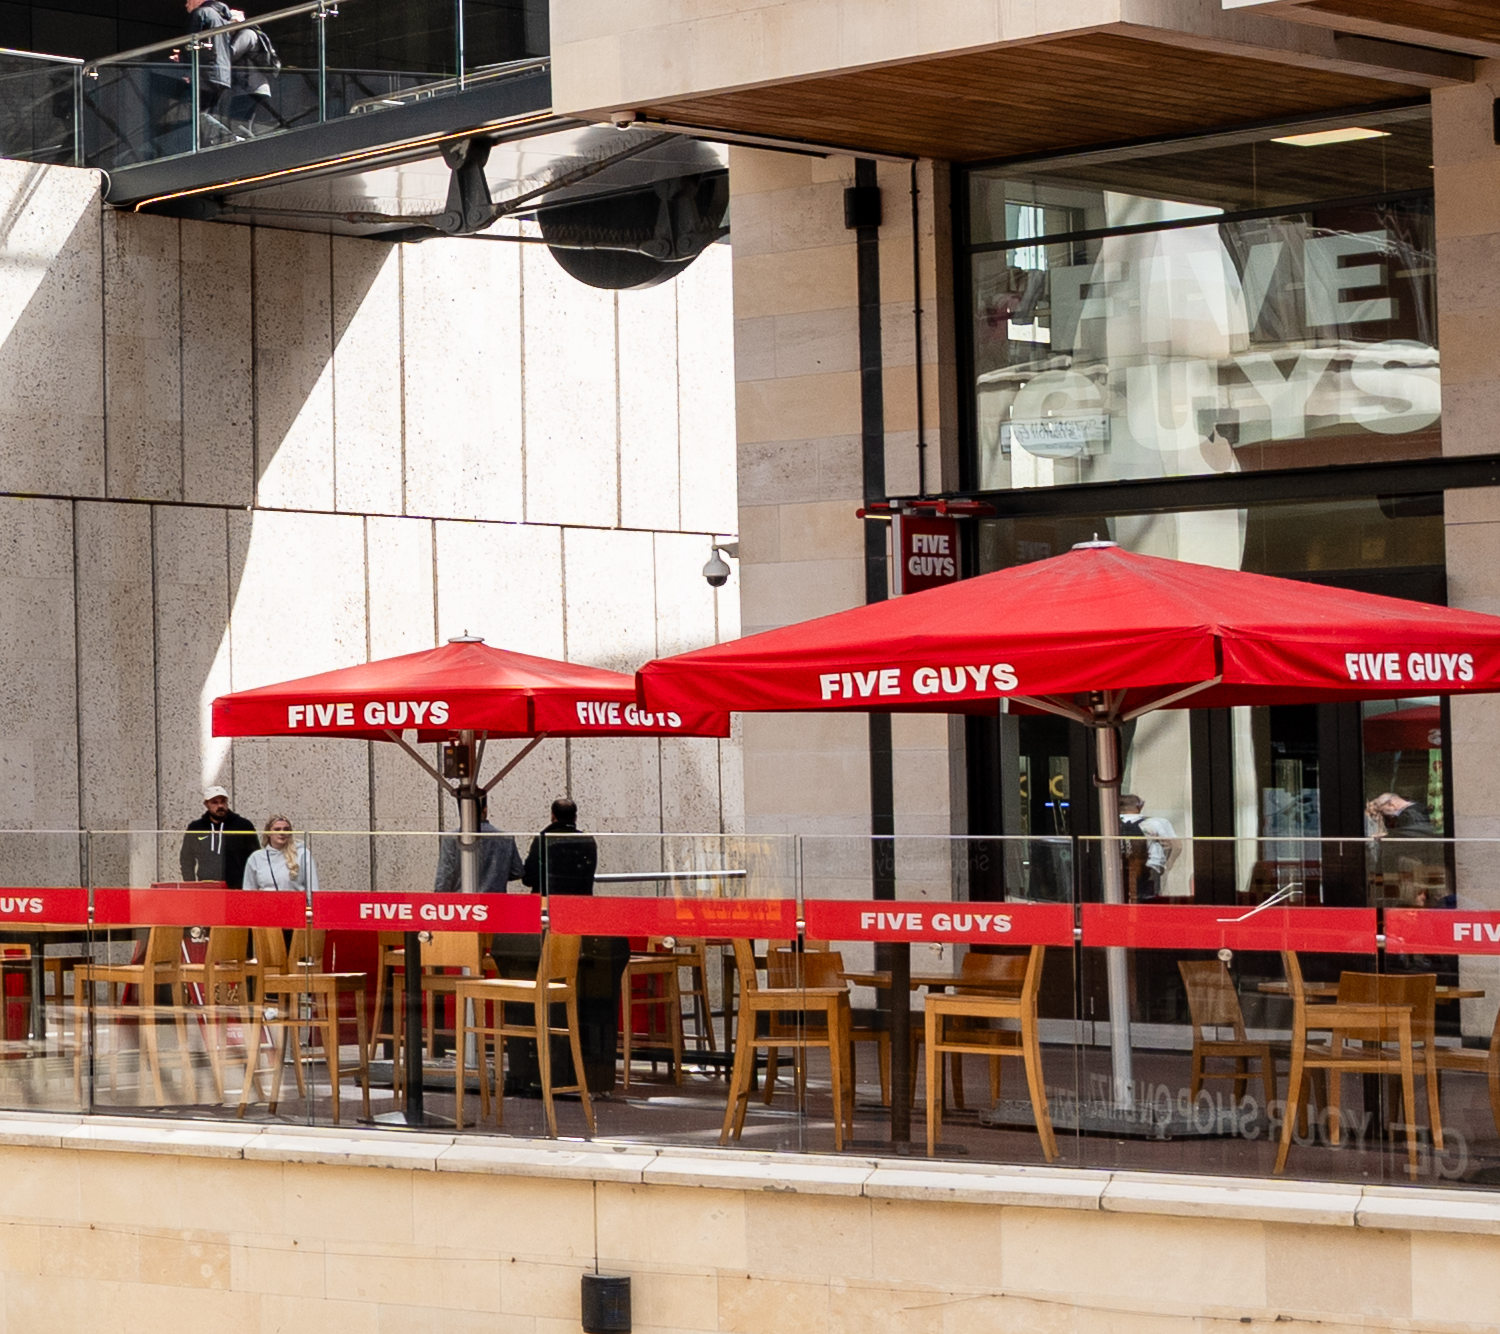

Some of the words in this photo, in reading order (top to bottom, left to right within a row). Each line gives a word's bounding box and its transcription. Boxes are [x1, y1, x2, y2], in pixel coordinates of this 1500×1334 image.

[1050, 229, 1398, 352] FIVE
[1012, 339, 1441, 459] GUYS
[912, 534, 949, 555] FIVE
[908, 557, 955, 577] GUYS
[1345, 653, 1401, 681] FIVE
[1407, 652, 1474, 681] GUYS
[819, 668, 901, 700] FIVE
[912, 663, 1019, 694] GUYS
[289, 703, 354, 727] FIVE
[363, 701, 449, 725] GUYS
[576, 701, 621, 725] FIVE
[359, 903, 413, 920] FIVE
[419, 903, 488, 922] GUYS
[861, 913, 923, 931] FIVE
[931, 914, 1012, 933] GUYS
